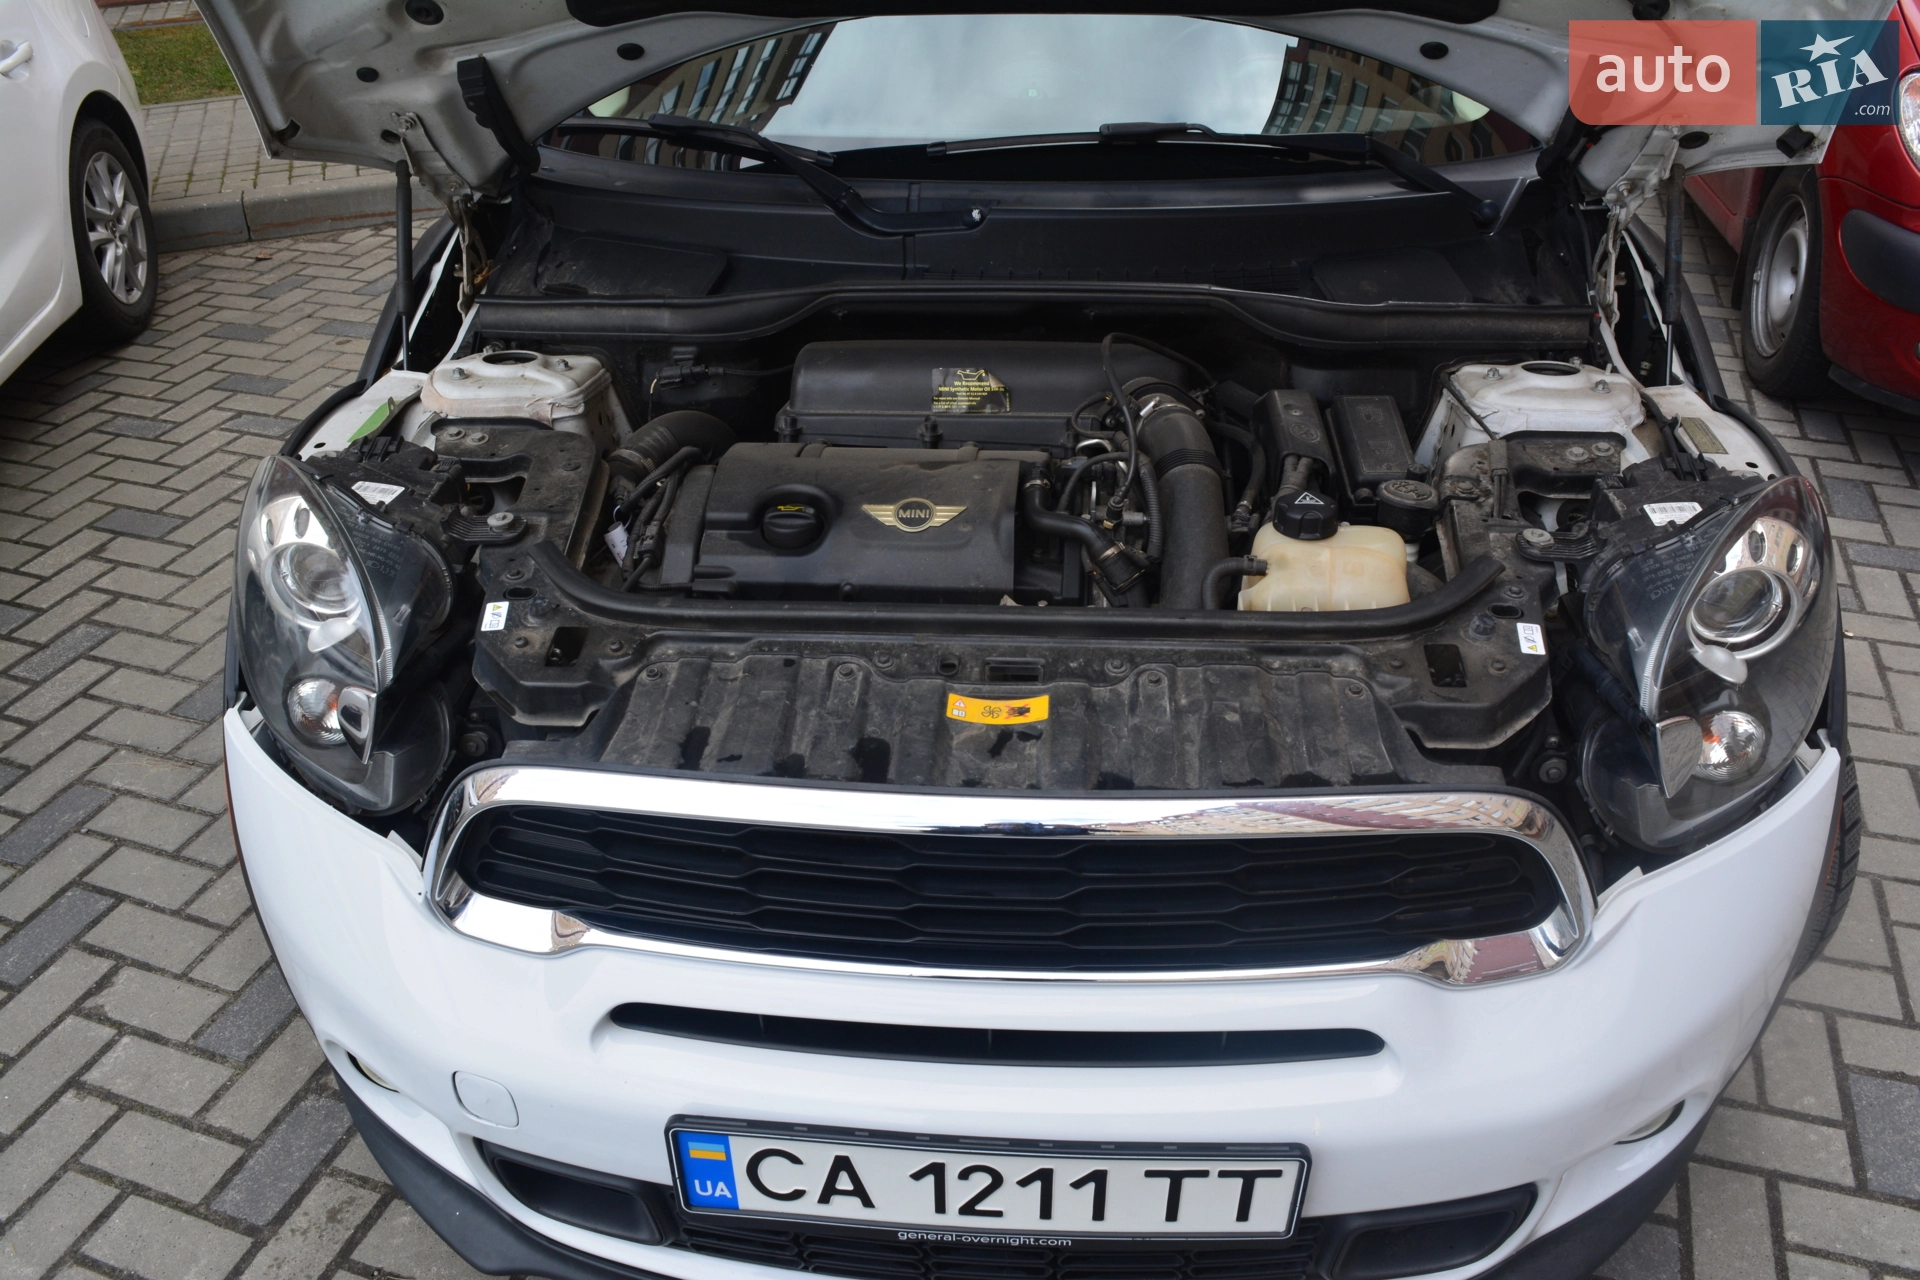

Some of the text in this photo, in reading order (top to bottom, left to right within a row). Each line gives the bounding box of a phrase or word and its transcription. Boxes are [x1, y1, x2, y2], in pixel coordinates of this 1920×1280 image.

[898, 508, 930, 518] MINI
[694, 1179, 732, 1198] UA
[746, 1148, 1283, 1222] CA 1211 TT
[898, 1231, 1072, 1246] general-overnight.com
